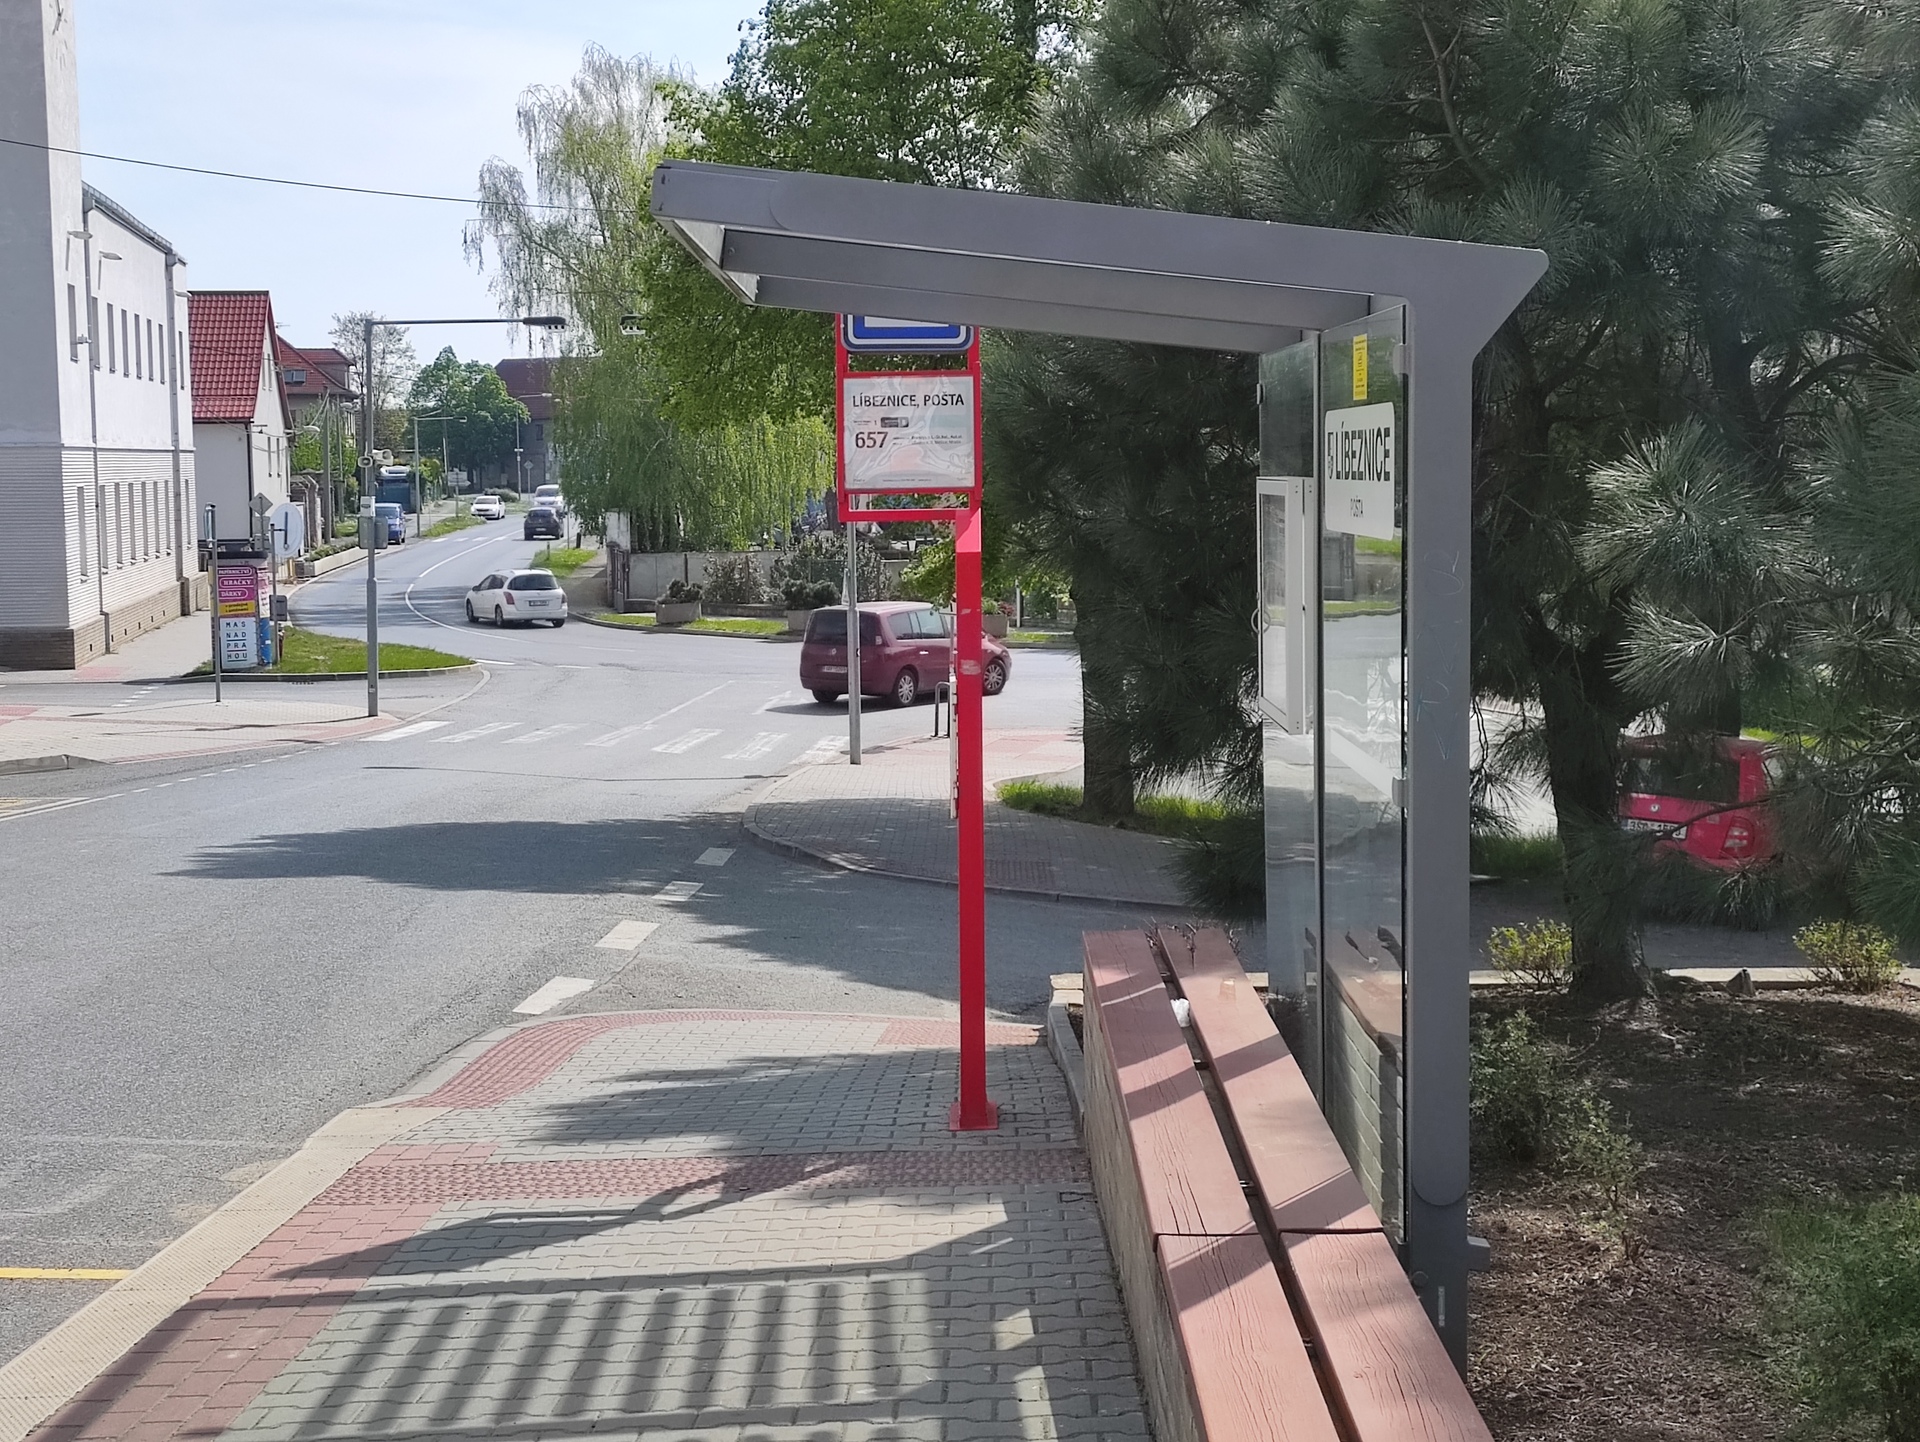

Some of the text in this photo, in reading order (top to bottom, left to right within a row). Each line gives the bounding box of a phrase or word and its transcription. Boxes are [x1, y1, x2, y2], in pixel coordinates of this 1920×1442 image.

[852, 391, 965, 408] LÍBEZNICE, POŠTA
[855, 431, 888, 449] 657
[1335, 421, 1391, 482] LÍBEZNICE
[1349, 495, 1364, 518] POŠTA
[225, 620, 246, 628] MAS
[227, 652, 248, 660] HOU
